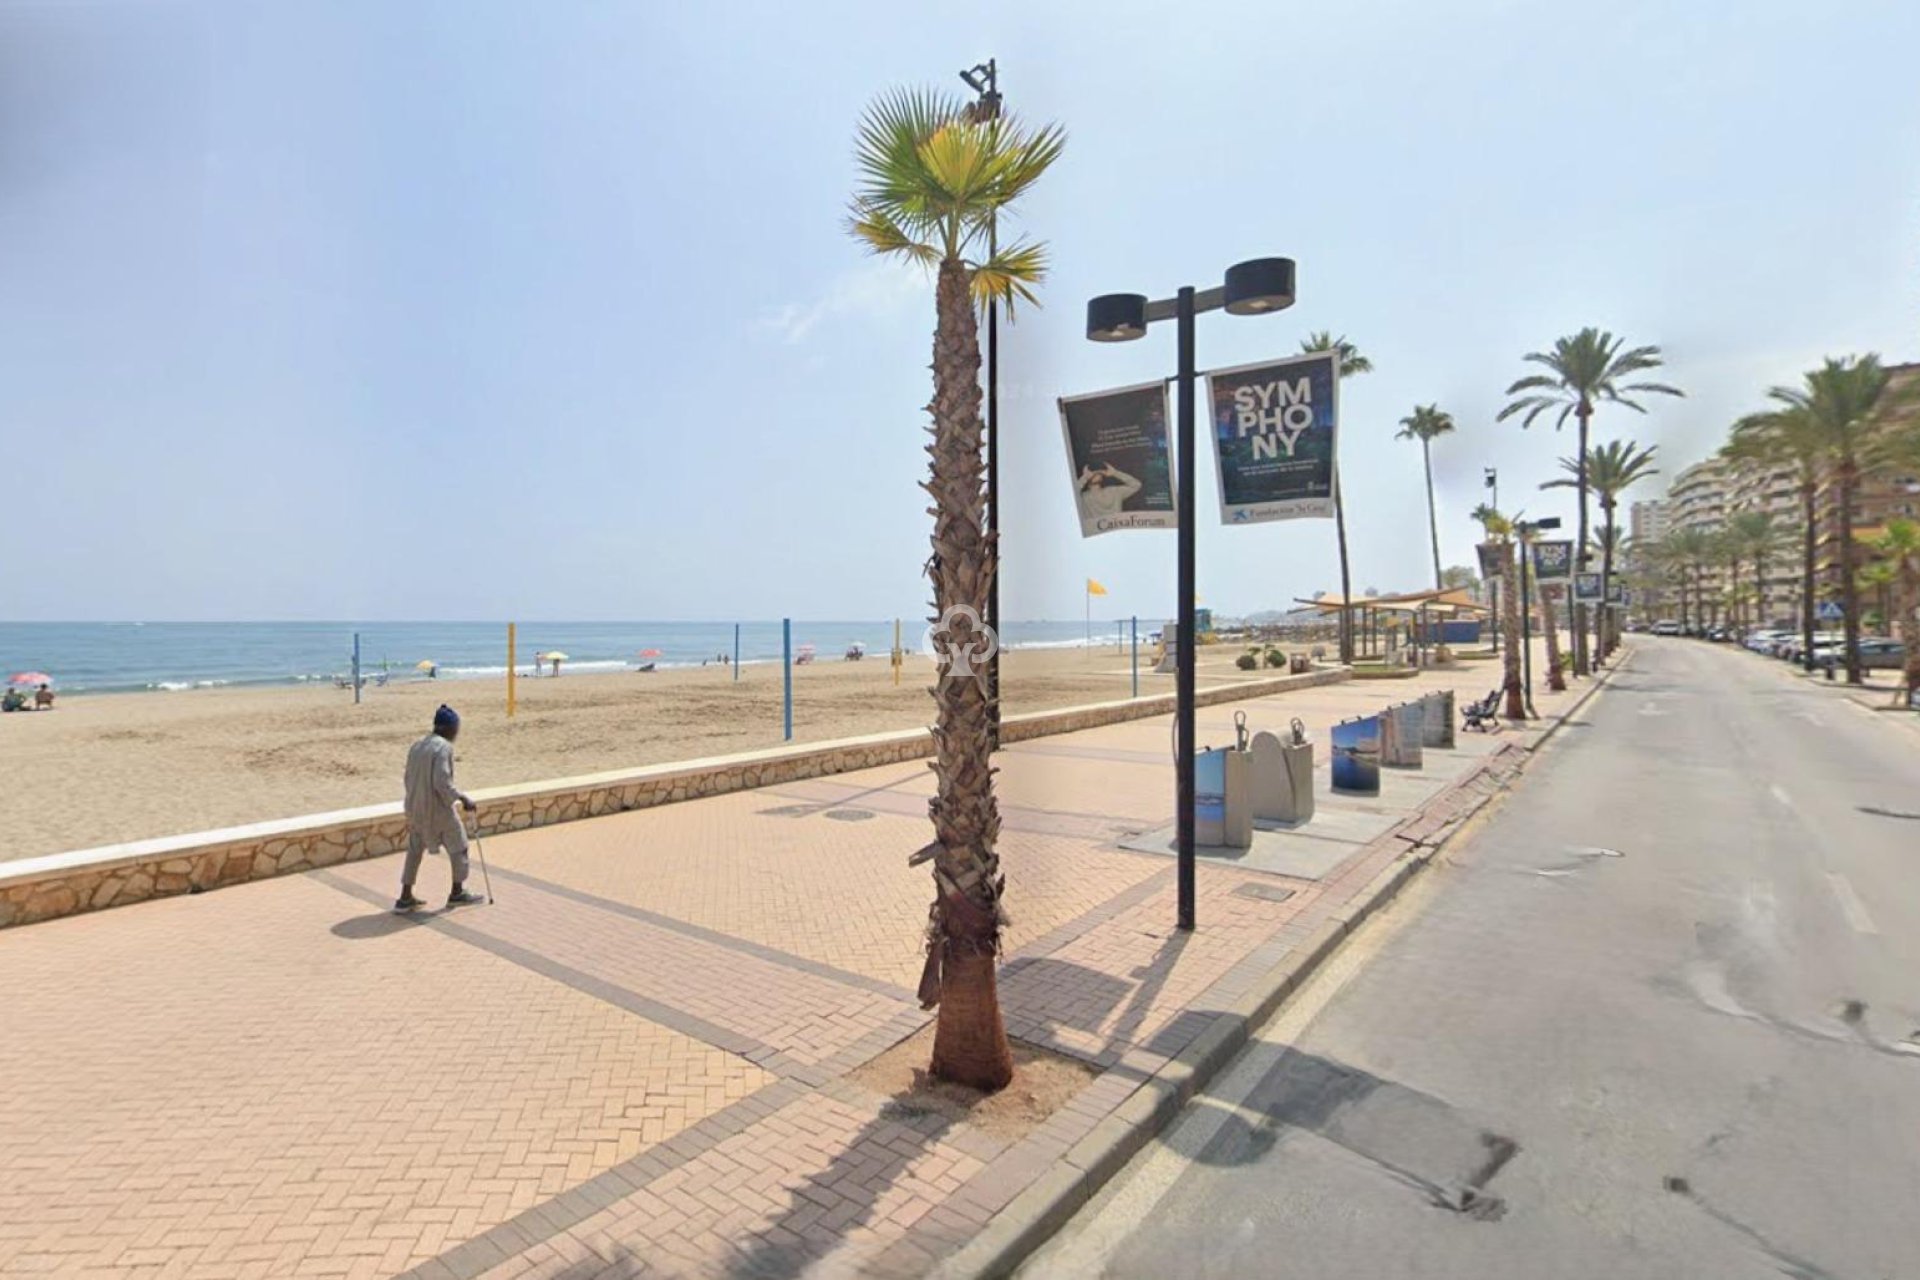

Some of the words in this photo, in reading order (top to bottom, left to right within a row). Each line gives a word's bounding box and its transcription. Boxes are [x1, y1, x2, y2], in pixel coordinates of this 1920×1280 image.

[1234, 377, 1311, 411] SYM
[1238, 404, 1313, 437] PHO
[1252, 430, 1300, 460] NY
